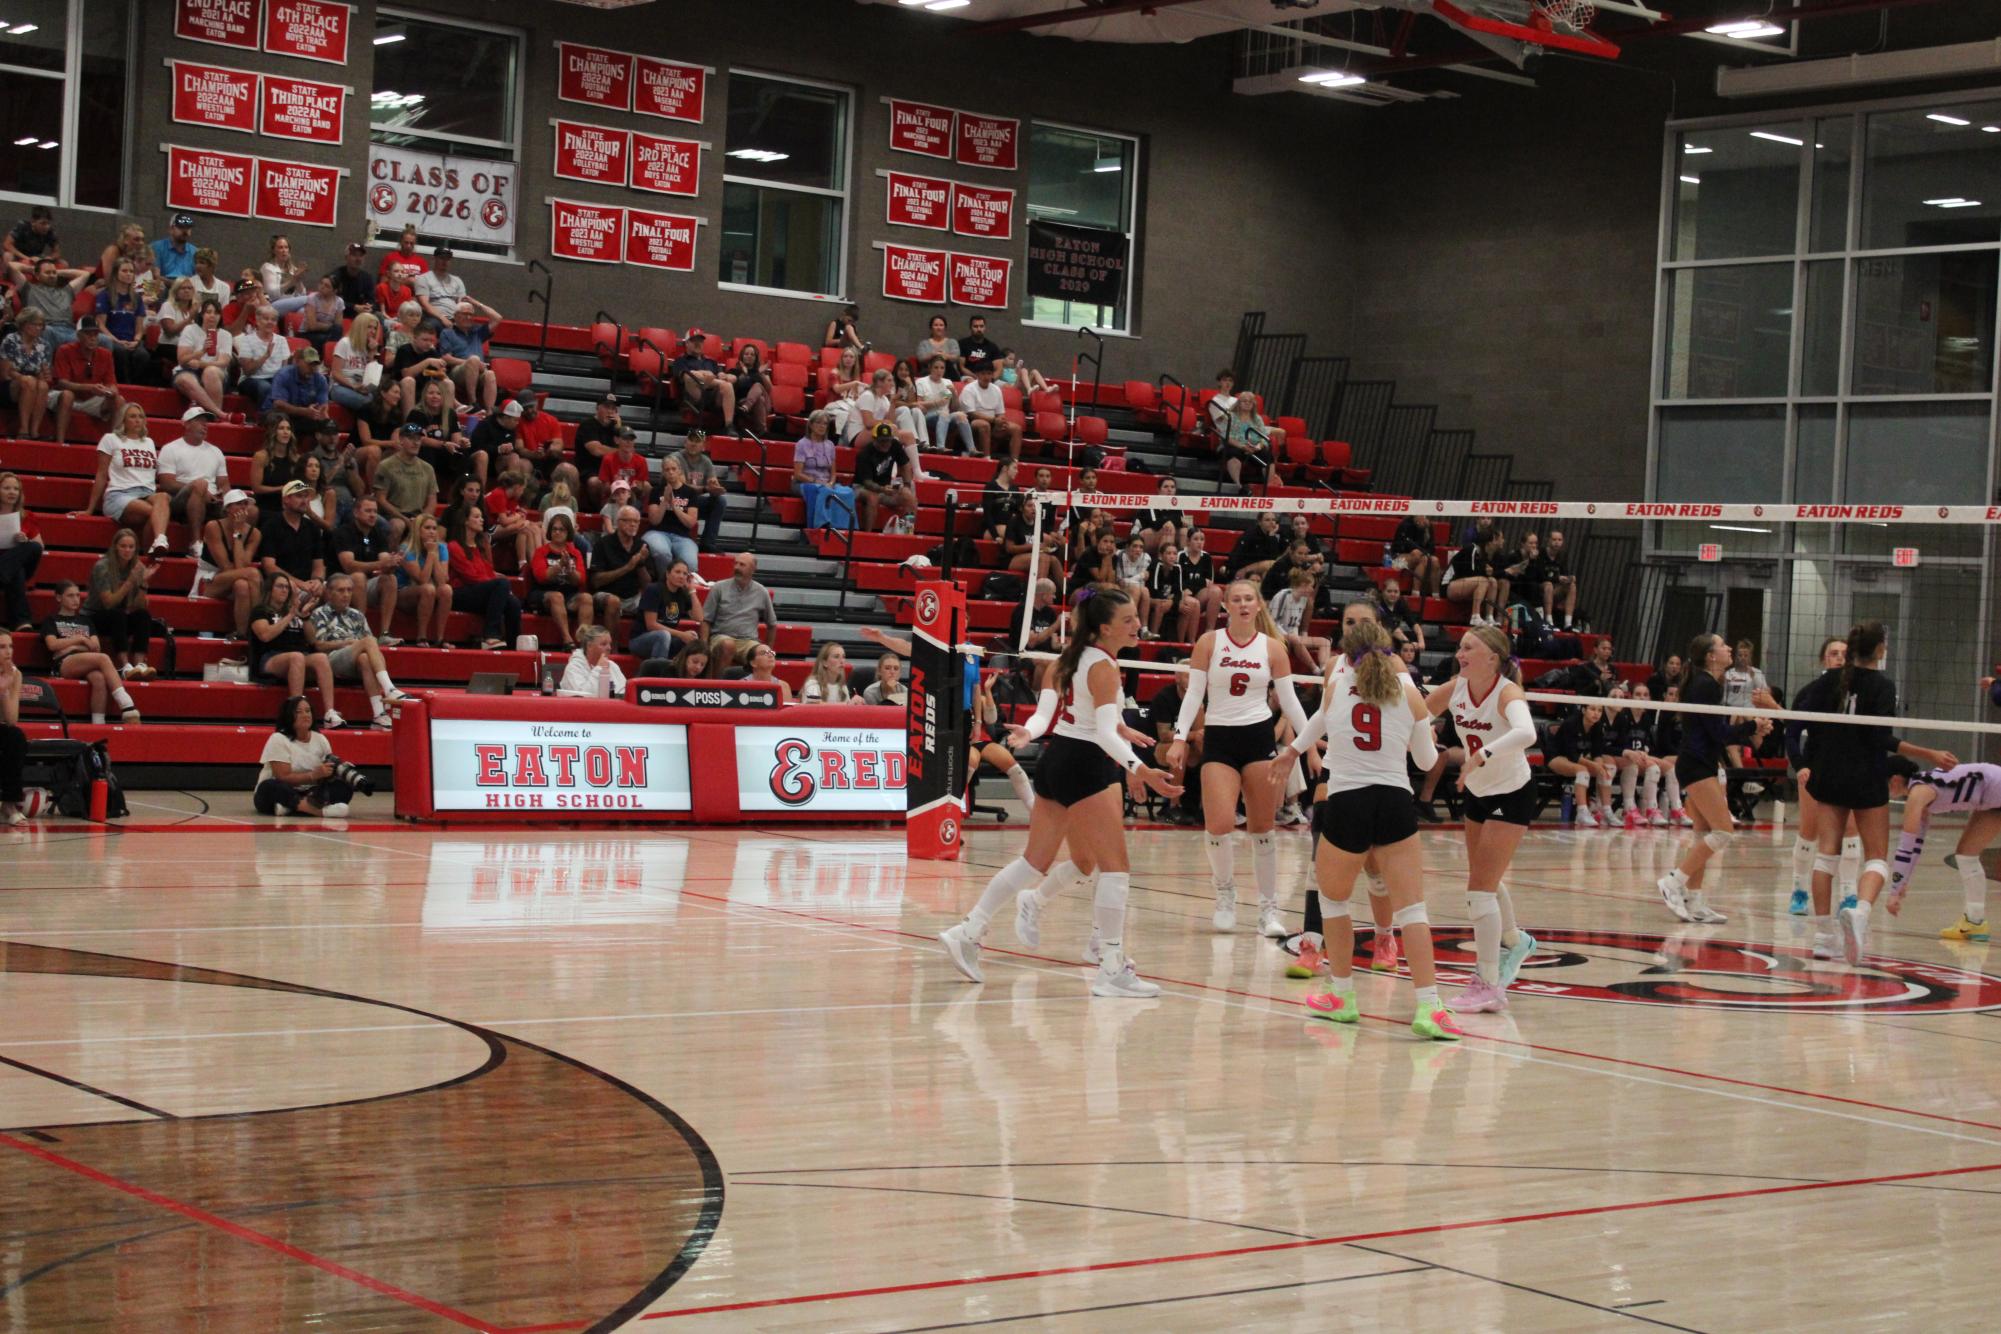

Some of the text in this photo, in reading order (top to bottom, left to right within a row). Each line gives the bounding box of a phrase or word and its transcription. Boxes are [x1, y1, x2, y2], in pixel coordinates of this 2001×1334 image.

[214, 0, 251, 19] PLACE
[296, 2, 322, 14] STATE
[201, 9, 234, 22] 2021 AA
[277, 6, 339, 33] 4TH PLACE
[189, 15, 245, 34] MARCHING BAND
[206, 28, 226, 38] EATON
[286, 32, 327, 47] BOYS TRACK
[296, 43, 316, 53] EATON
[586, 52, 609, 63] STATE
[570, 55, 624, 80] CHAMPIONS
[660, 67, 682, 77] STATE
[203, 72, 230, 82] STATE
[643, 69, 696, 93] CHAMPIONS
[184, 73, 248, 101] CHAMPIONS
[292, 85, 318, 96] STATE
[581, 81, 610, 93] FOOTBALL
[653, 86, 684, 99] 2023 AAA
[271, 87, 338, 114] THIRD PLACE
[586, 90, 604, 99] EATON
[654, 95, 682, 107] BASEBALL
[196, 102, 235, 114] WRESTLING
[660, 104, 676, 113] EATON
[205, 111, 225, 121] EATON
[274, 113, 331, 129] MARCHING BAND
[896, 110, 948, 133] FINAL FOUR
[292, 124, 312, 134] EATON
[582, 130, 604, 140] STATE
[965, 123, 1011, 143] CHAMPIONS
[564, 132, 620, 158] FINAL FOUR
[654, 143, 677, 152] STATE
[199, 156, 224, 167] STATE
[638, 146, 690, 168] 3RD PLACE
[573, 158, 608, 171] VOLLEYBALL
[647, 162, 679, 174] 2023 AAA
[180, 159, 243, 186] CHAMPIONS
[286, 167, 311, 178] STATE
[371, 158, 509, 196] CLASS OF
[581, 168, 599, 176] EATON
[644, 170, 681, 182] BOYS TRACK
[266, 170, 329, 196] CHAMPIONS
[654, 180, 671, 188] EATON
[193, 188, 227, 200] BASEBALL
[893, 182, 945, 203] FINAL FOUR
[200, 198, 219, 207] EATON
[279, 199, 312, 210] SOFTBALL
[407, 192, 471, 220] 2026
[957, 193, 1008, 214] FINAL FOUR
[285, 208, 305, 217] EATON
[577, 209, 600, 218] STATE
[905, 205, 933, 215] VOLLEYBALL
[560, 211, 616, 234] CHAMPIONS
[654, 219, 671, 228] STATE
[571, 228, 604, 241] 2023 AAA
[632, 221, 689, 244] FINAL FOUR
[570, 238, 604, 248] WRESTLING
[649, 238, 672, 247] 2023 AA
[1055, 236, 1100, 253] EATON
[577, 247, 594, 255] EATON
[648, 245, 672, 255] FOOTBALL
[651, 254, 667, 262] EATON
[907, 252, 927, 262] STATE
[970, 259, 990, 268] STATE
[1030, 247, 1123, 270] HIGH SCHOOL
[892, 254, 939, 276] CHAMPIONS
[900, 270, 928, 282] 2024 AAA
[955, 262, 1003, 284] FINAL FOUR
[1043, 263, 1108, 281] CLASS OF
[902, 280, 926, 290] BASEBALL
[965, 278, 992, 288] 2024 AAA
[1059, 279, 1090, 293] 2029
[979, 288, 993, 296] TRACK
[1082, 494, 1150, 506] EATON REDS
[1200, 497, 1274, 509] EATON REDS
[1329, 499, 1410, 512] EATON REDS
[1470, 501, 1558, 514] EATON REDS
[1625, 504, 1723, 518] EATON REDS
[1795, 505, 1904, 520] EATON REDS
[1701, 545, 1717, 560] EXIT
[1896, 548, 1913, 565] EXIT
[1219, 656, 1261, 670] Eaton
[1229, 673, 1250, 696] 6
[695, 692, 720, 704] POSS
[908, 666, 925, 780] EATON
[925, 693, 936, 754] REDS
[1351, 702, 1382, 751] 9
[1456, 715, 1493, 731] Eaton
[531, 726, 591, 738] Welcome to
[822, 731, 879, 745] Home of the
[474, 743, 649, 788] EATON
[485, 793, 643, 808] HIGH SCHOOL
